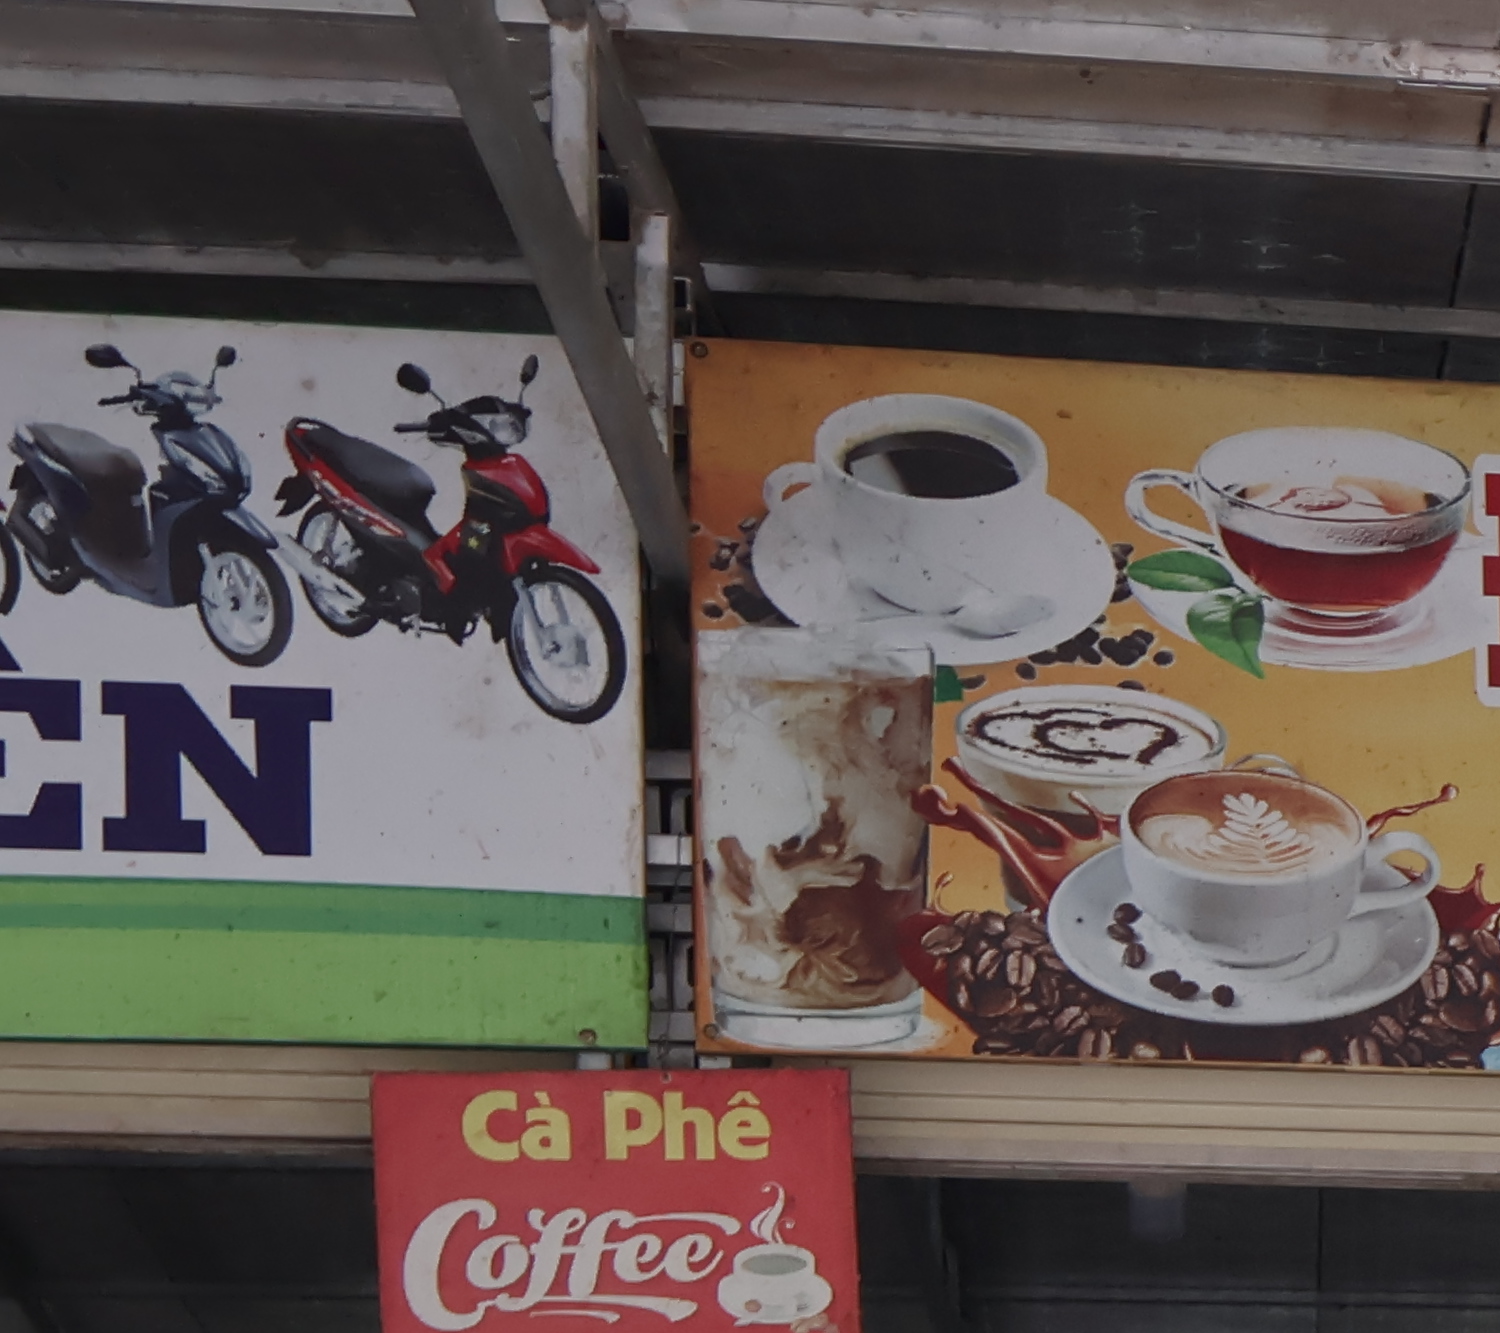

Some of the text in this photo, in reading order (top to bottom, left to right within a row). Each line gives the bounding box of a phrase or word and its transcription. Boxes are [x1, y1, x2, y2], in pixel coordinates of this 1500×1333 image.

[462, 1089, 770, 1162] Cà Phê
[404, 1197, 738, 1331] Coffee
